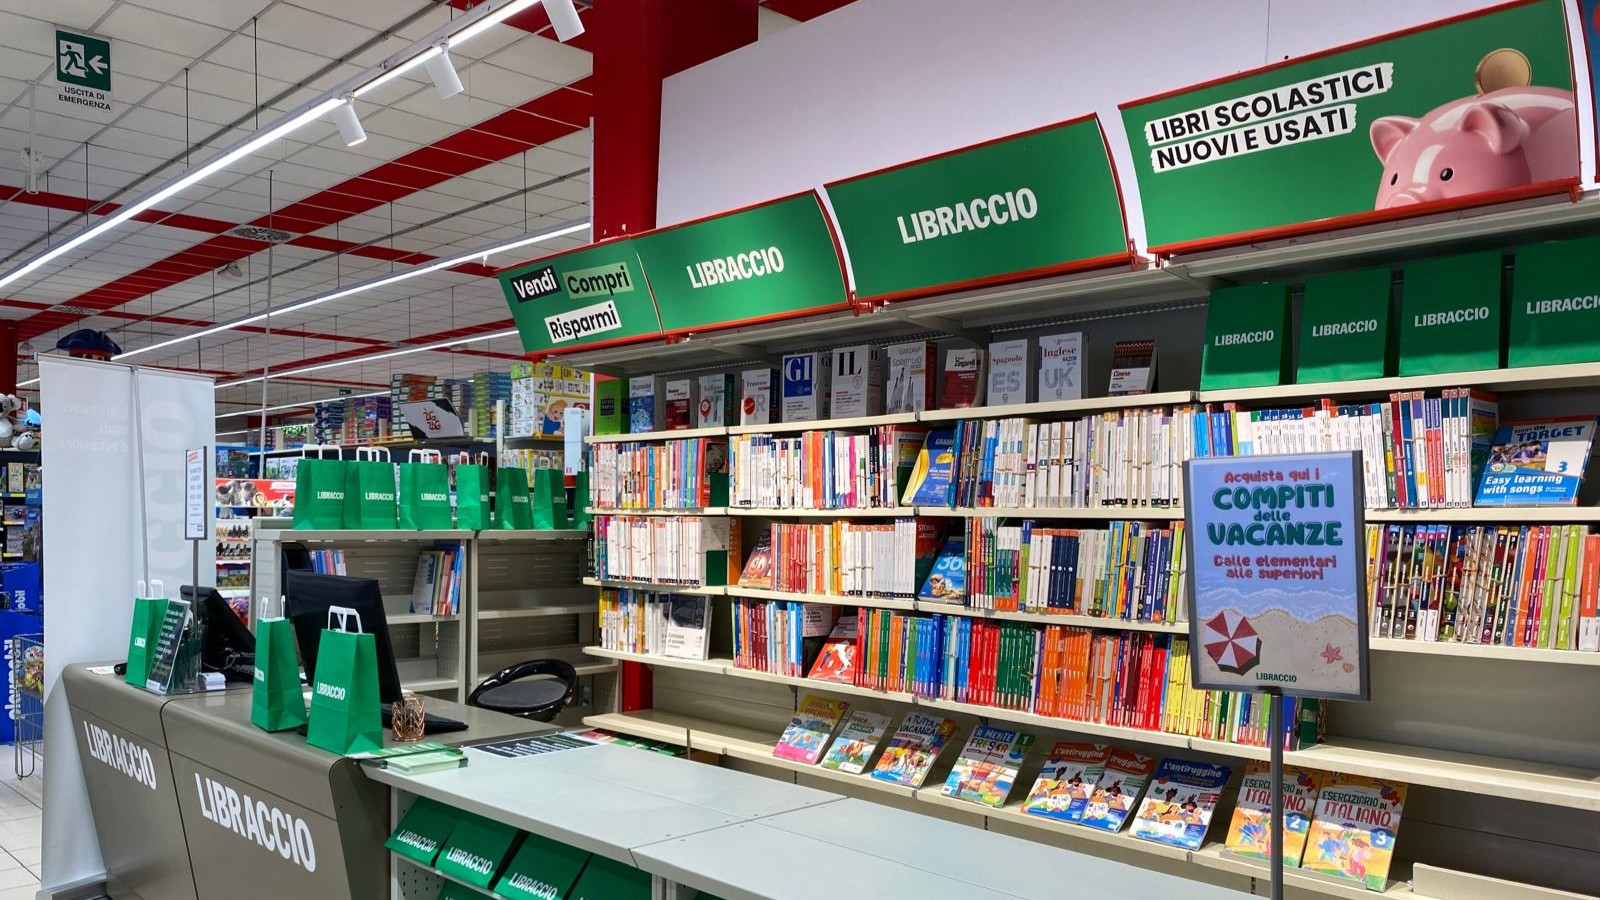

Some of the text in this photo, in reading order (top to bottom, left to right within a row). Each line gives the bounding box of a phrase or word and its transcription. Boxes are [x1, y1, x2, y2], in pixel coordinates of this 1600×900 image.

[64, 86, 105, 100] USCITA DI
[58, 94, 111, 111] EMERGENZA
[1151, 67, 1385, 142] LIBRI SCOLASTICI
[1157, 108, 1348, 169] NUOVI E USATI
[897, 187, 1038, 244] LIBRACCIO
[686, 246, 784, 289] LIBRACCIO
[513, 265, 629, 299] Vendi Compri
[1526, 295, 1600, 314] LIBRACCI
[548, 303, 617, 340] Risparmi
[1414, 306, 1489, 328] LIBRACCIO
[1312, 319, 1377, 337] LIBRACCIO
[1214, 330, 1274, 347] LIBRACCIO
[1044, 347, 1076, 357] Inglese
[785, 357, 811, 382] GI
[1045, 367, 1074, 389] UK
[1516, 426, 1585, 442] TARGET
[1558, 461, 1568, 473] 3
[1224, 468, 1320, 484] Acquista qui i
[1486, 474, 1563, 485] Easy learning
[1212, 483, 1335, 510] COMPITI
[1484, 485, 1507, 494] with
[1509, 485, 1543, 495] songs
[1253, 511, 1291, 522] delle
[1207, 521, 1343, 546] VACANZE
[1255, 555, 1337, 567] elementari
[1226, 568, 1324, 580] alle superiori
[1256, 672, 1297, 683] LIBRACCIO
[316, 682, 346, 700] LIBRACCIO
[900, 724, 936, 736] VACANZA
[985, 729, 1014, 743] MENTE
[969, 738, 1008, 753] FRESCA
[1055, 747, 1104, 759] L'antiruggine
[84, 721, 157, 790] LIBRACCIO
[1163, 762, 1222, 778] L'antiruggine
[1296, 788, 1303, 796] DI
[1322, 790, 1388, 811] ESERCIZIARIO DI
[194, 772, 316, 873] LIBRACCIO
[1290, 816, 1300, 829] 2
[1324, 801, 1391, 827] ITALIANO
[397, 829, 437, 853] LIBRACCIO
[1376, 831, 1387, 846] 3
[446, 846, 493, 875] LIBRACCIO
[508, 872, 557, 900] LIBRACCIO
